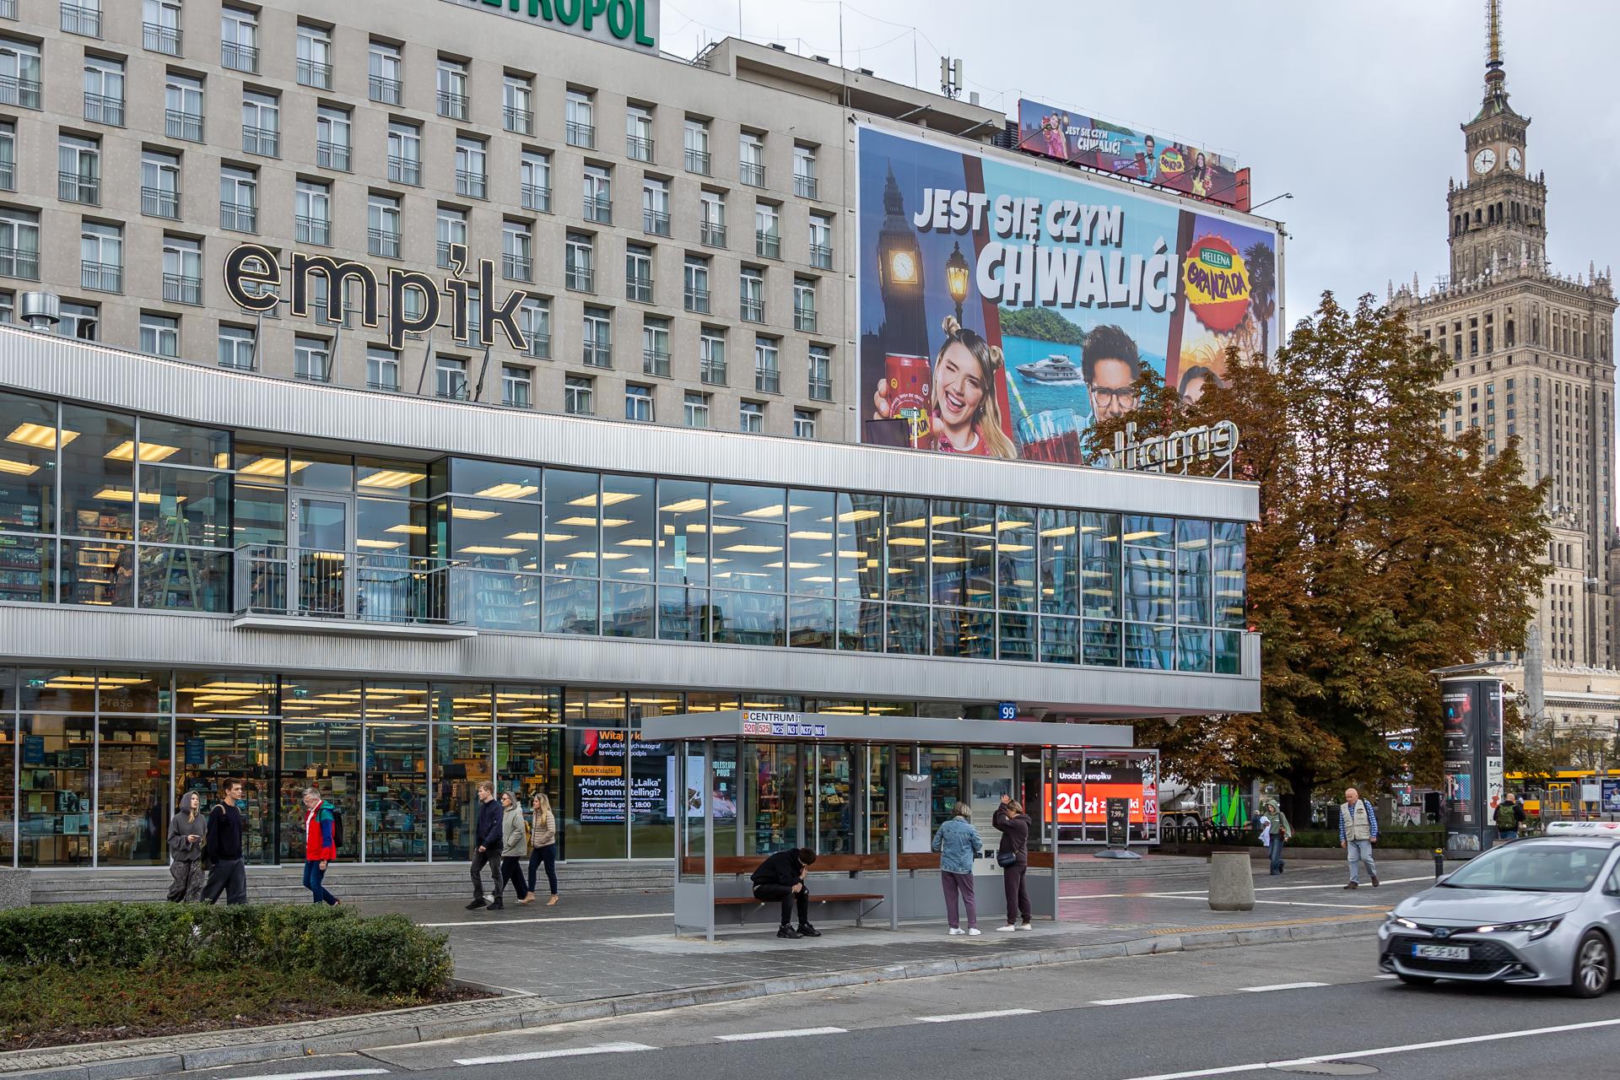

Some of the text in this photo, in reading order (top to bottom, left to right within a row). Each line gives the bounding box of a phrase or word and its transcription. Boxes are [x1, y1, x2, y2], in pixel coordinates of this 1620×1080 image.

[913, 187, 1124, 248] JEST SIĘ CZYM
[1201, 251, 1231, 266] HELLENA
[976, 235, 1179, 314] CHWALIĆ!
[1187, 261, 1248, 301] ORANŻADA
[224, 243, 529, 350] empik
[749, 712, 795, 722] CENTRUM
[1002, 706, 1015, 719] 99
[599, 730, 624, 742] Witaj
[581, 788, 592, 796] Po
